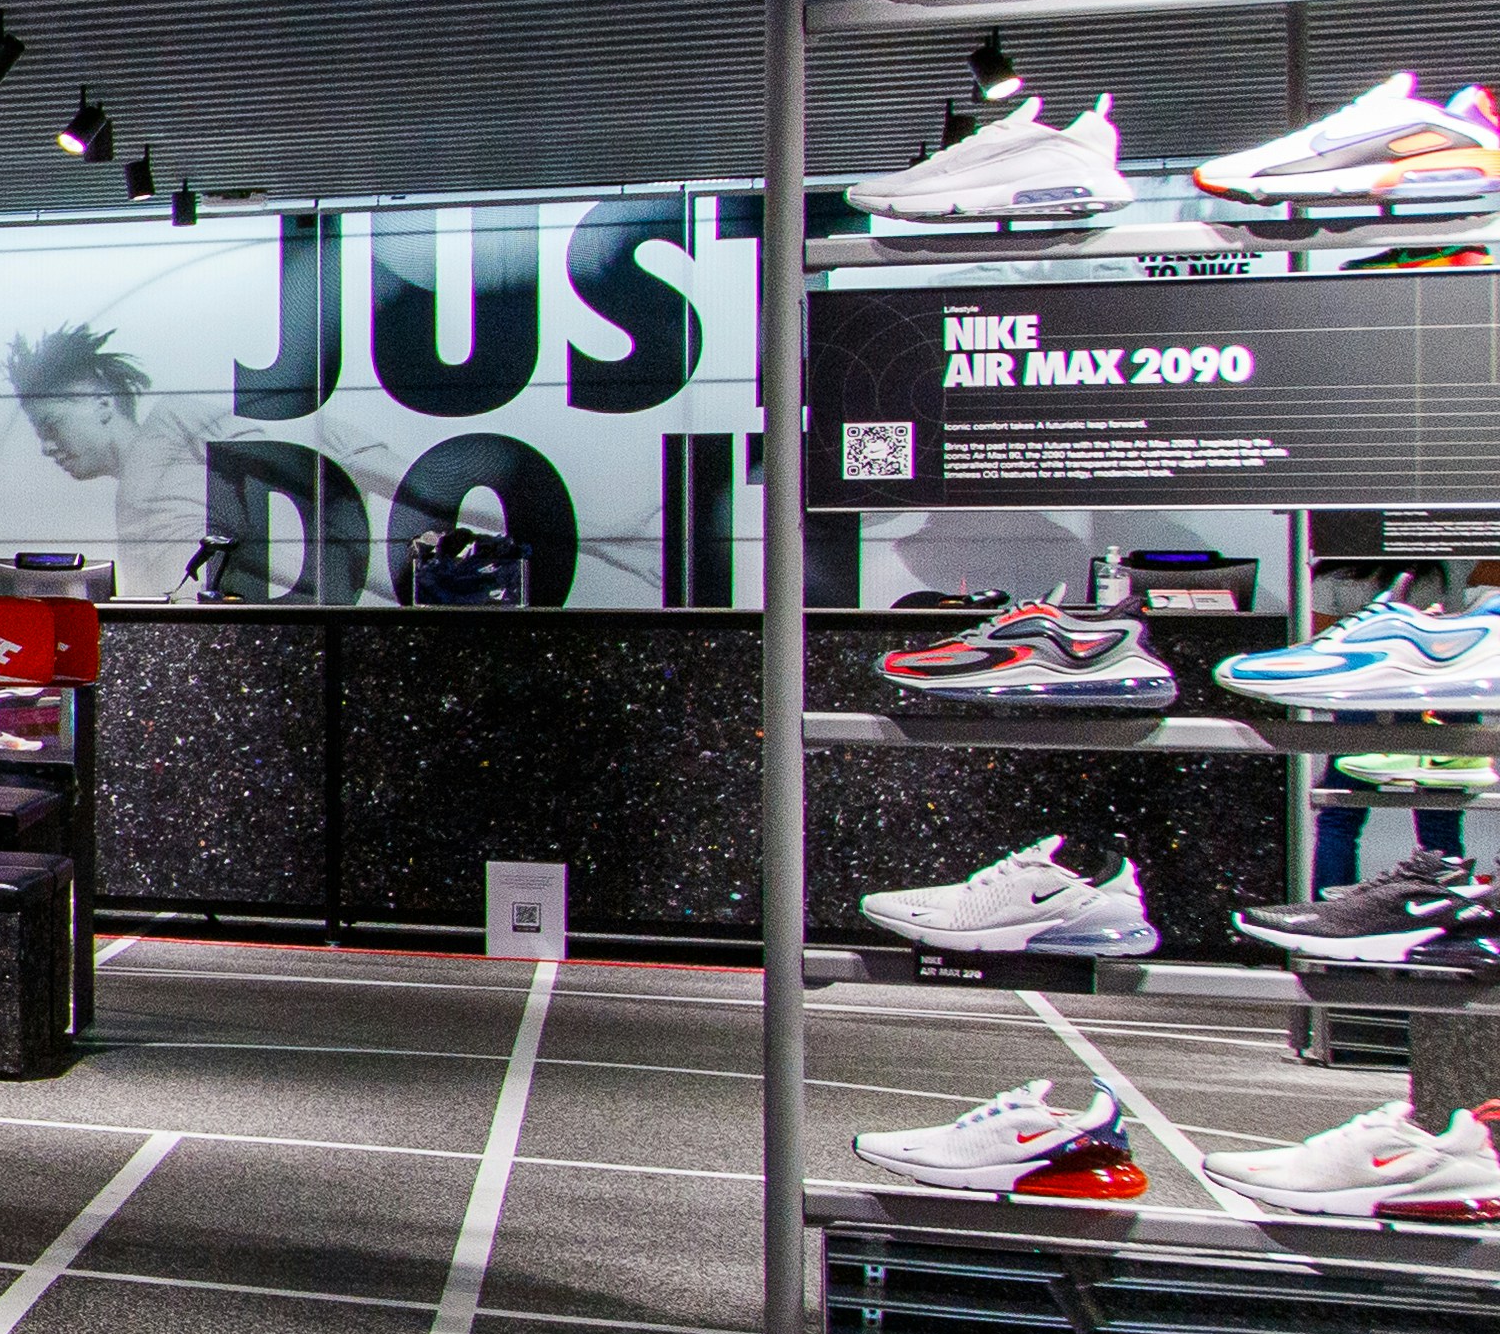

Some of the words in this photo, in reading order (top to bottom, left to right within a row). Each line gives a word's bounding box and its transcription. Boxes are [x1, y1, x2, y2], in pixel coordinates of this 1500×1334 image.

[943, 315, 1039, 350] NIKE
[943, 353, 1016, 387] AIR
[1023, 349, 1126, 385] MAX
[1130, 345, 1255, 384] 2090
[206, 432, 577, 607] DO
